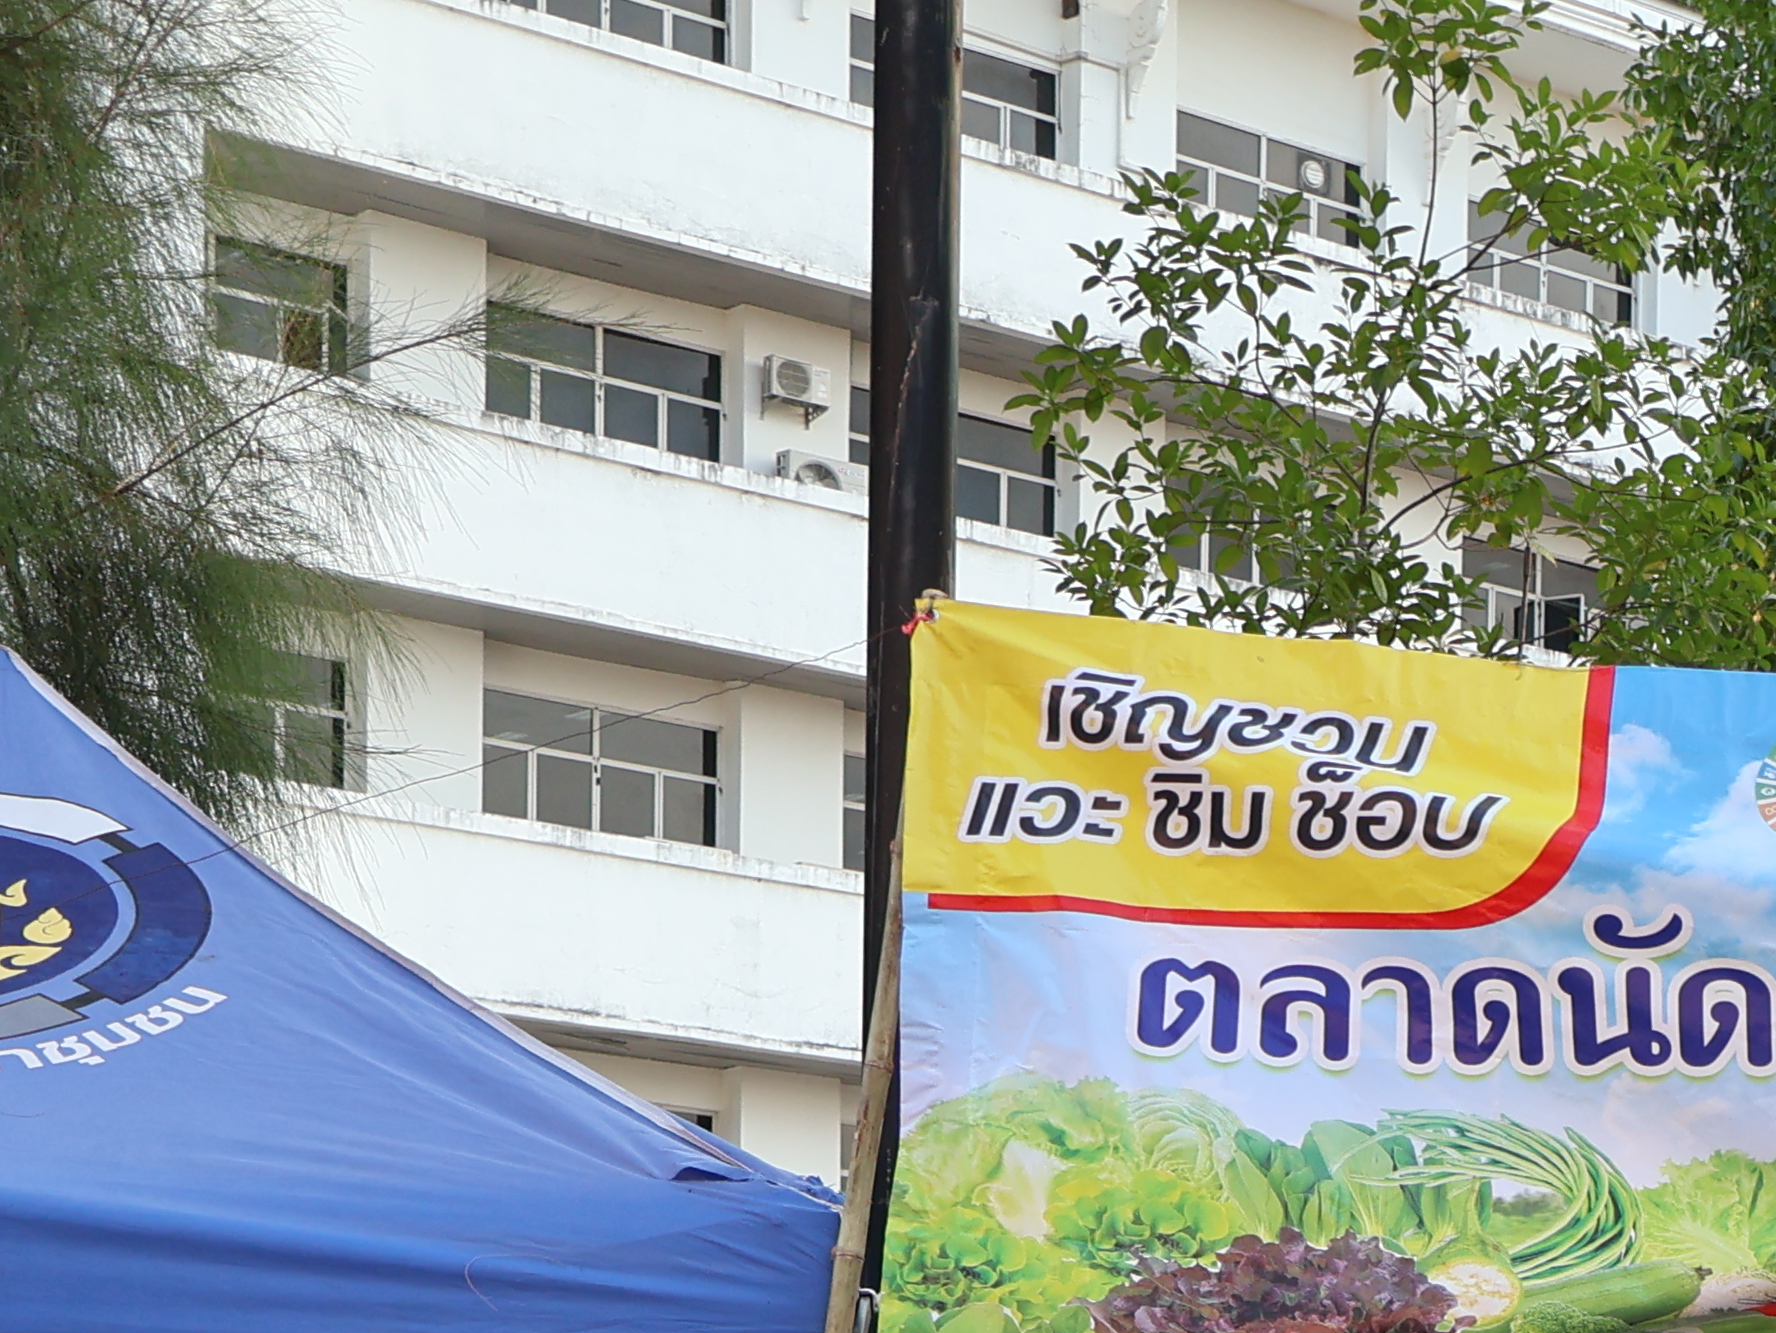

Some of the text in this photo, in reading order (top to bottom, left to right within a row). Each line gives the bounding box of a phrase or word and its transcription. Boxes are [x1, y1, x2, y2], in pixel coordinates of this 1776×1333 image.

[965, 781, 1122, 837] แวะ
[1150, 772, 1267, 850] ชิม
[1138, 911, 1774, 1068] ตลาดนัด
